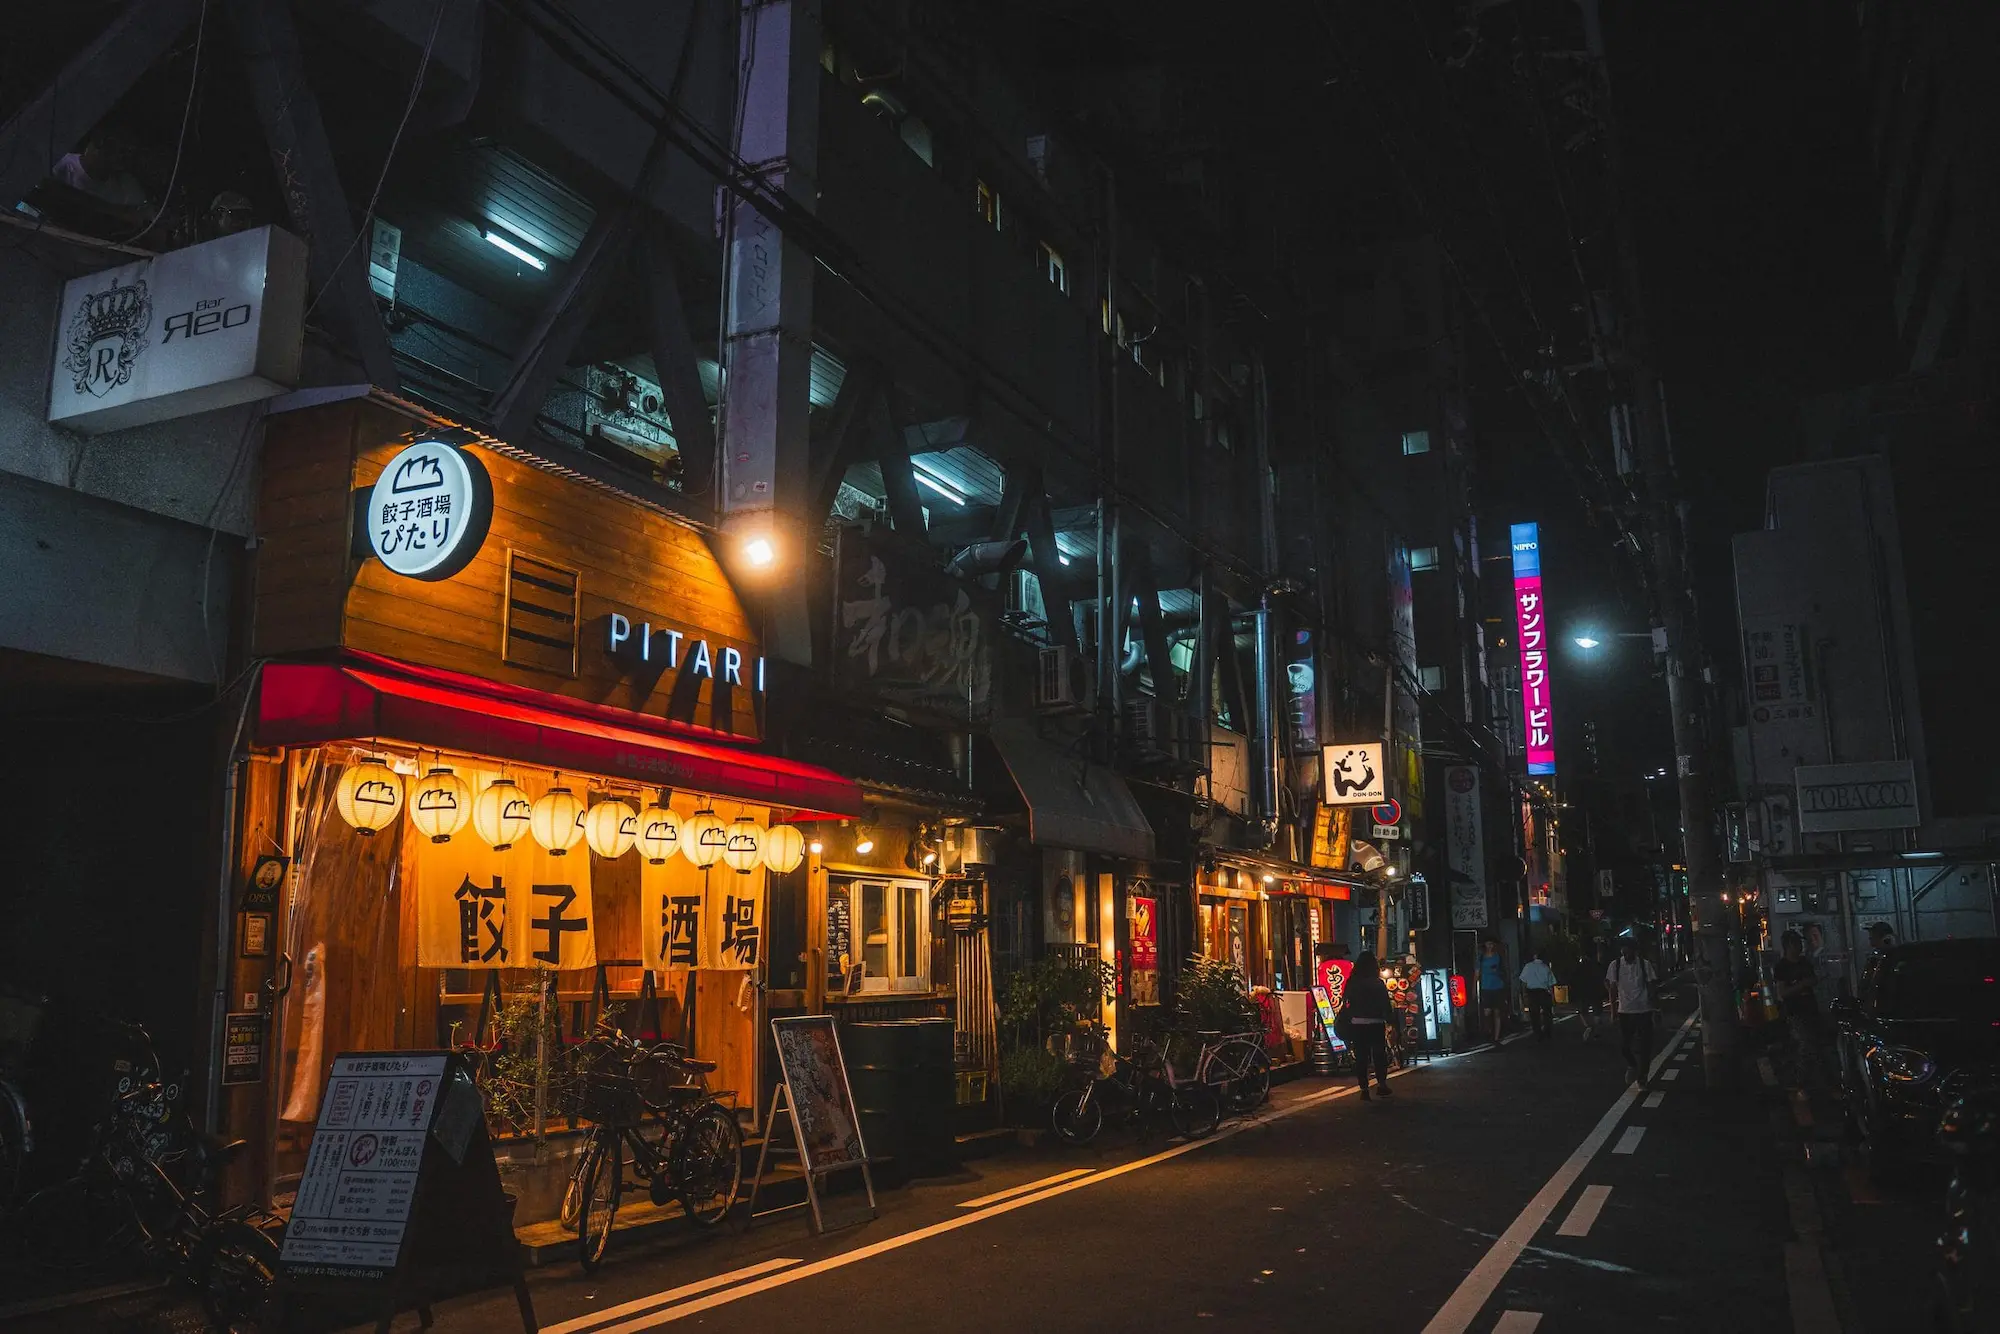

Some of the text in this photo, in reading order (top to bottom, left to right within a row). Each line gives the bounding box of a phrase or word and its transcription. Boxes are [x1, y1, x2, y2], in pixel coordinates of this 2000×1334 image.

[196, 298, 225, 312] Bar
[382, 494, 452, 525] 餃子酒場
[381, 517, 450, 555] ぴたり
[1513, 542, 1537, 552] NIPPO
[610, 612, 765, 692] PITARI
[1520, 593, 1550, 747] サンフラワービル
[1805, 784, 1908, 809] TOBACCO
